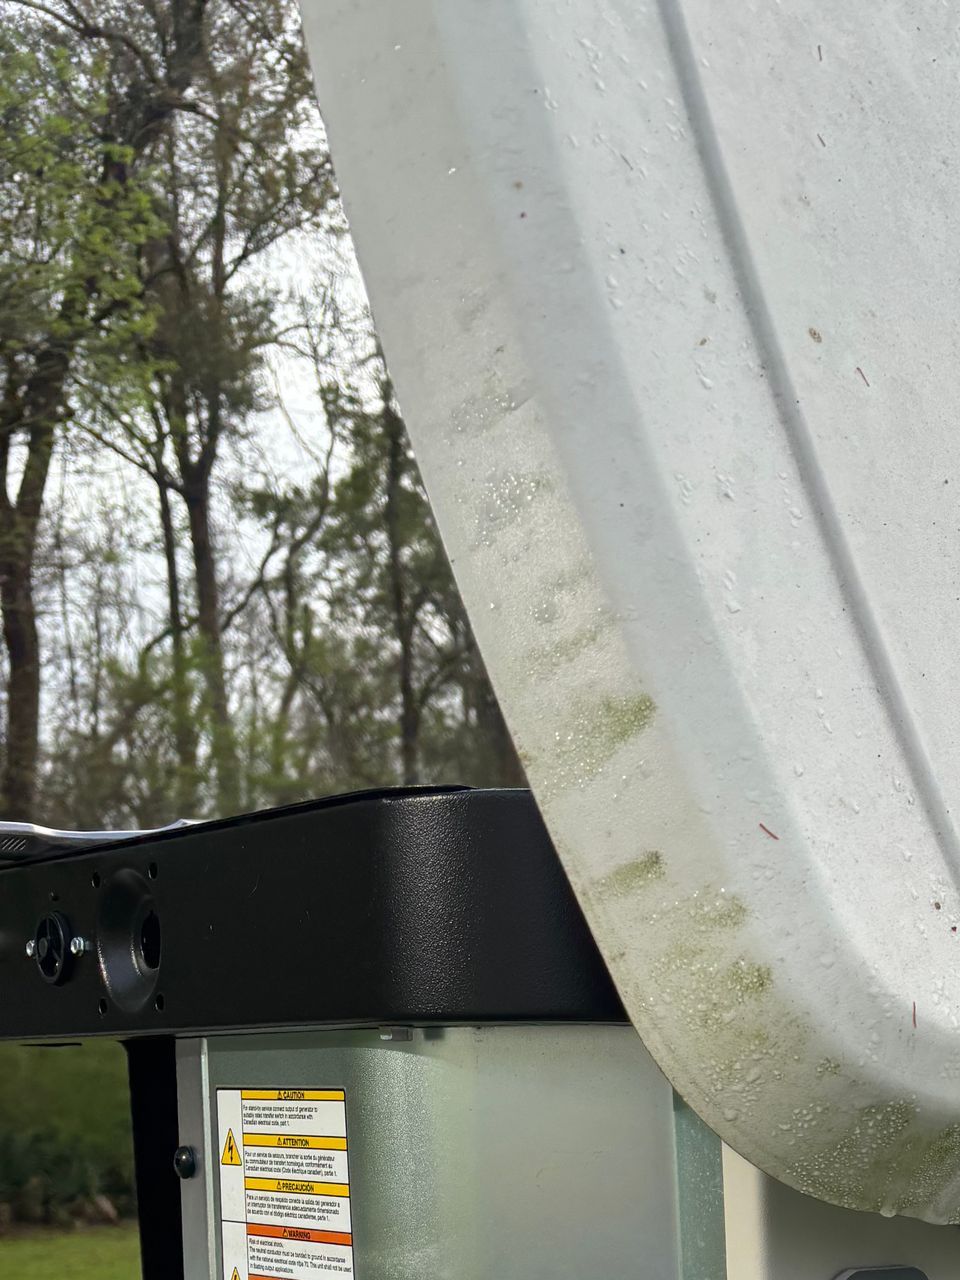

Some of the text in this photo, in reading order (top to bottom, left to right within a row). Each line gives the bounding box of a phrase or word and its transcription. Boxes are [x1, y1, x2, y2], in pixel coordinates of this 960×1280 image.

[283, 1091, 304, 1099] CAUTION
[282, 1137, 309, 1146] ATTENTION
[282, 1182, 314, 1192] PRECAUCIÓN
[288, 1230, 310, 1239] WARNING
